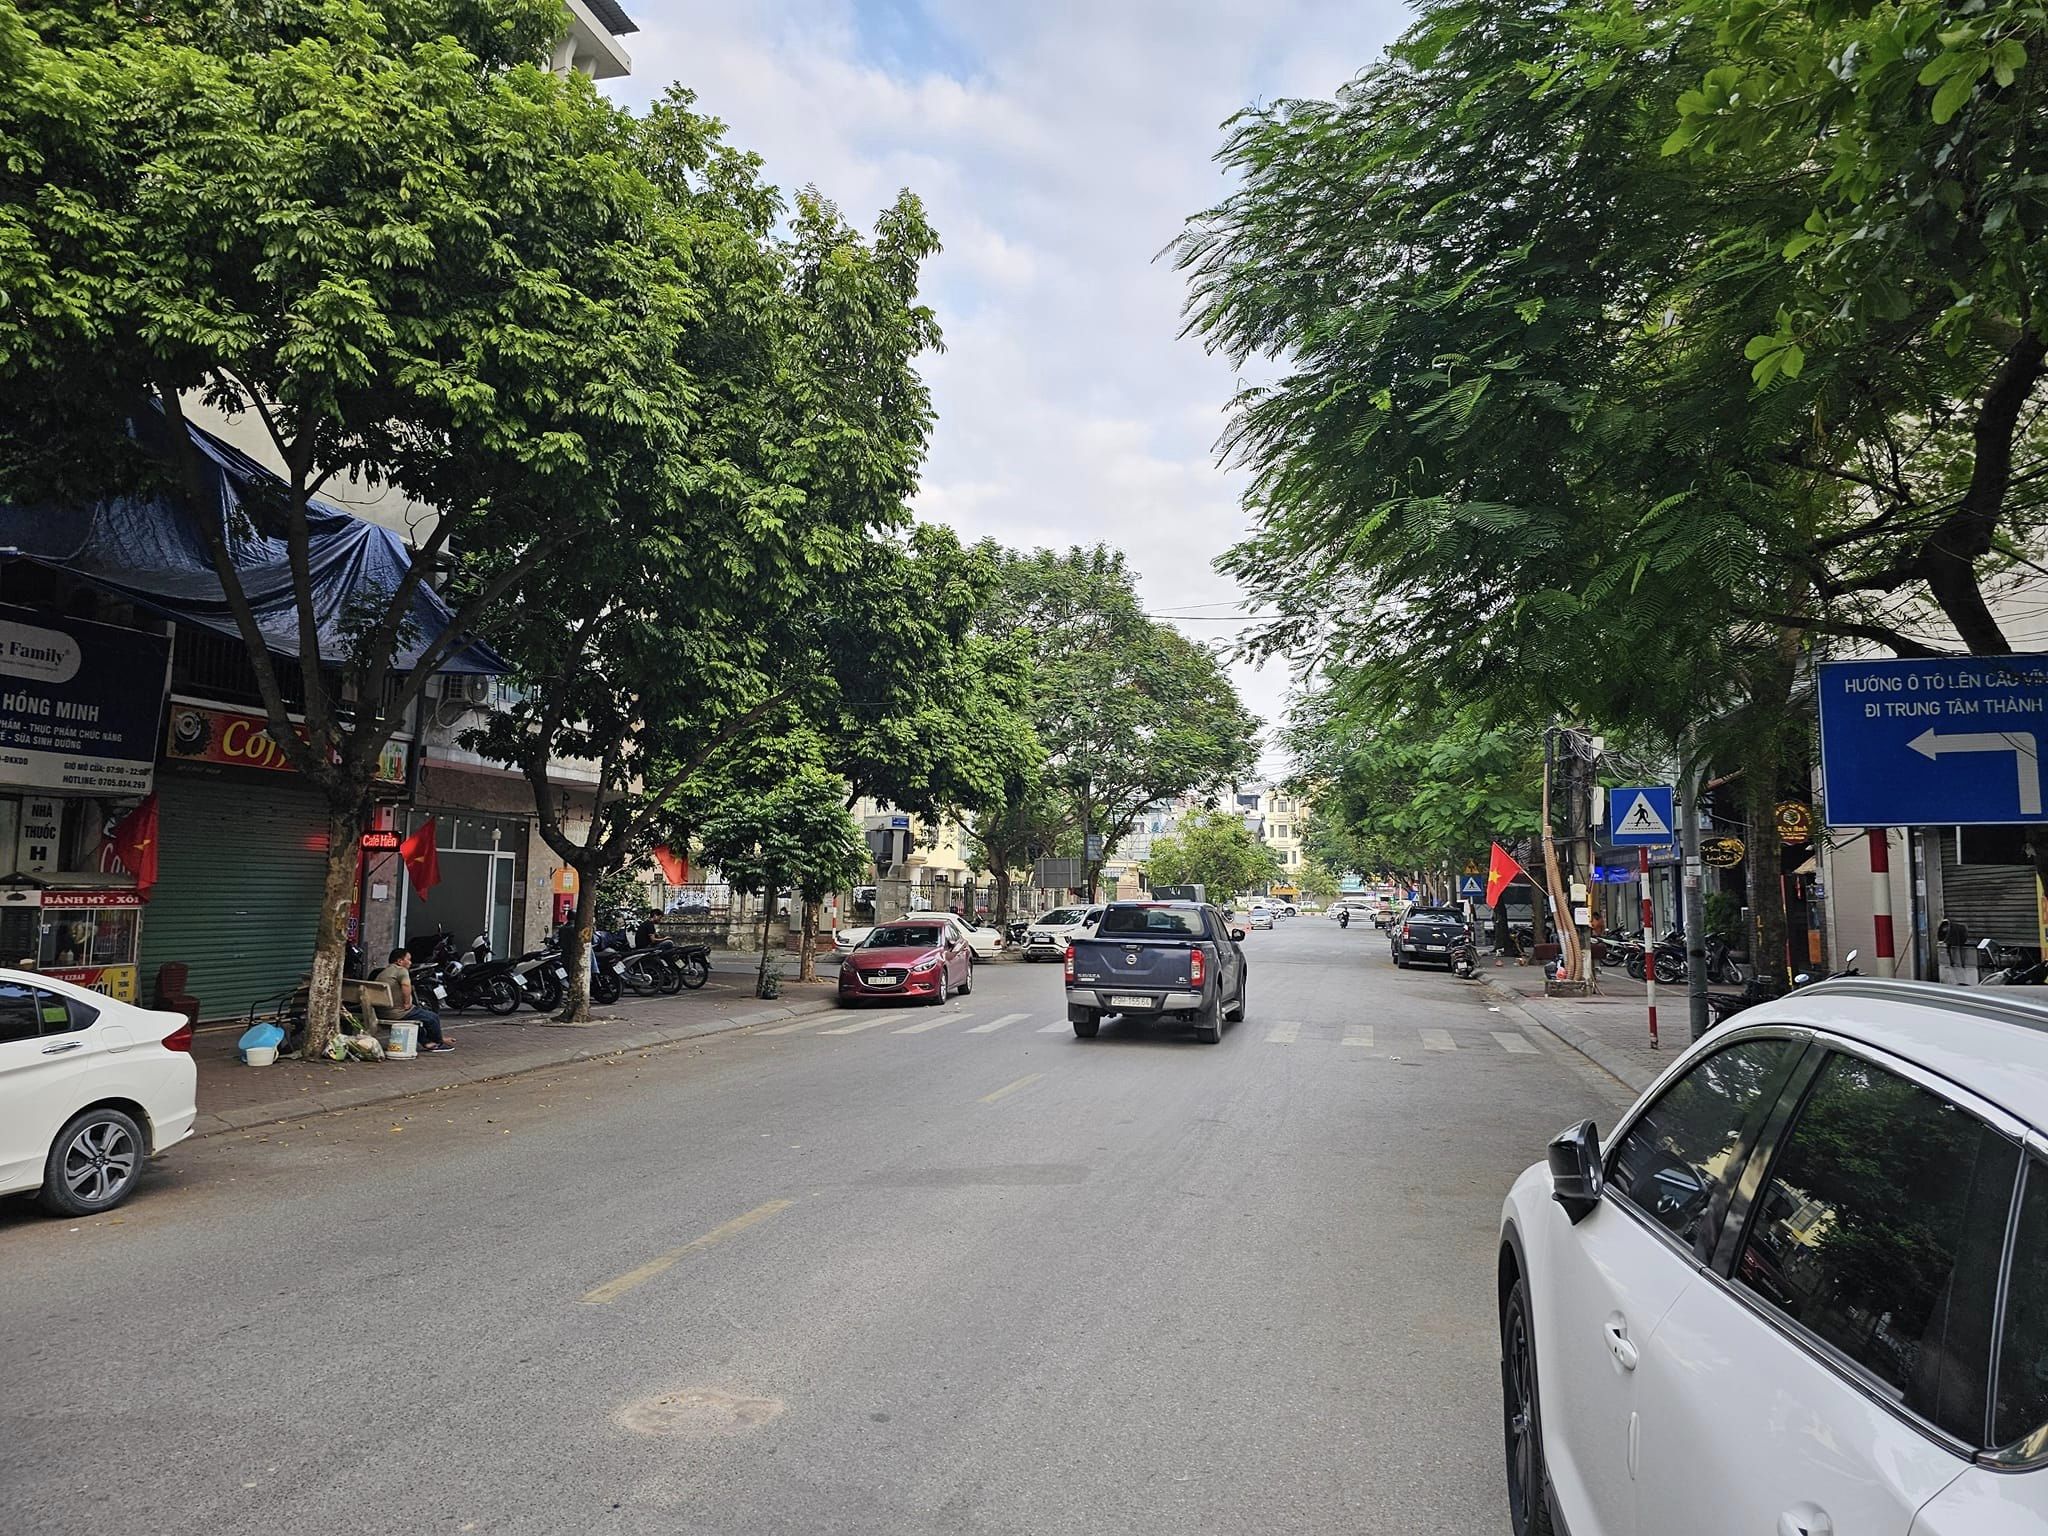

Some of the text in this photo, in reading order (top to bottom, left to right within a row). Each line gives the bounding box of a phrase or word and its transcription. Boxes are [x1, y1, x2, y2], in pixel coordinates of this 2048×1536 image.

[10, 641, 65, 666] Family
[1845, 674, 1902, 693] HƯỚNG
[1907, 673, 1919, 690] Ô
[1922, 672, 1944, 690] TÔ
[1948, 671, 1981, 689] LÊN
[3, 690, 100, 722] HỒNG MINH
[1864, 696, 2043, 718] ĐI TRUNG TÂM THÀNH
[62, 774, 97, 786] HOTLINE:
[32, 802, 53, 818] NHÀ
[24, 822, 56, 840] THUỐC
[44, 894, 83, 904] BÁNH
